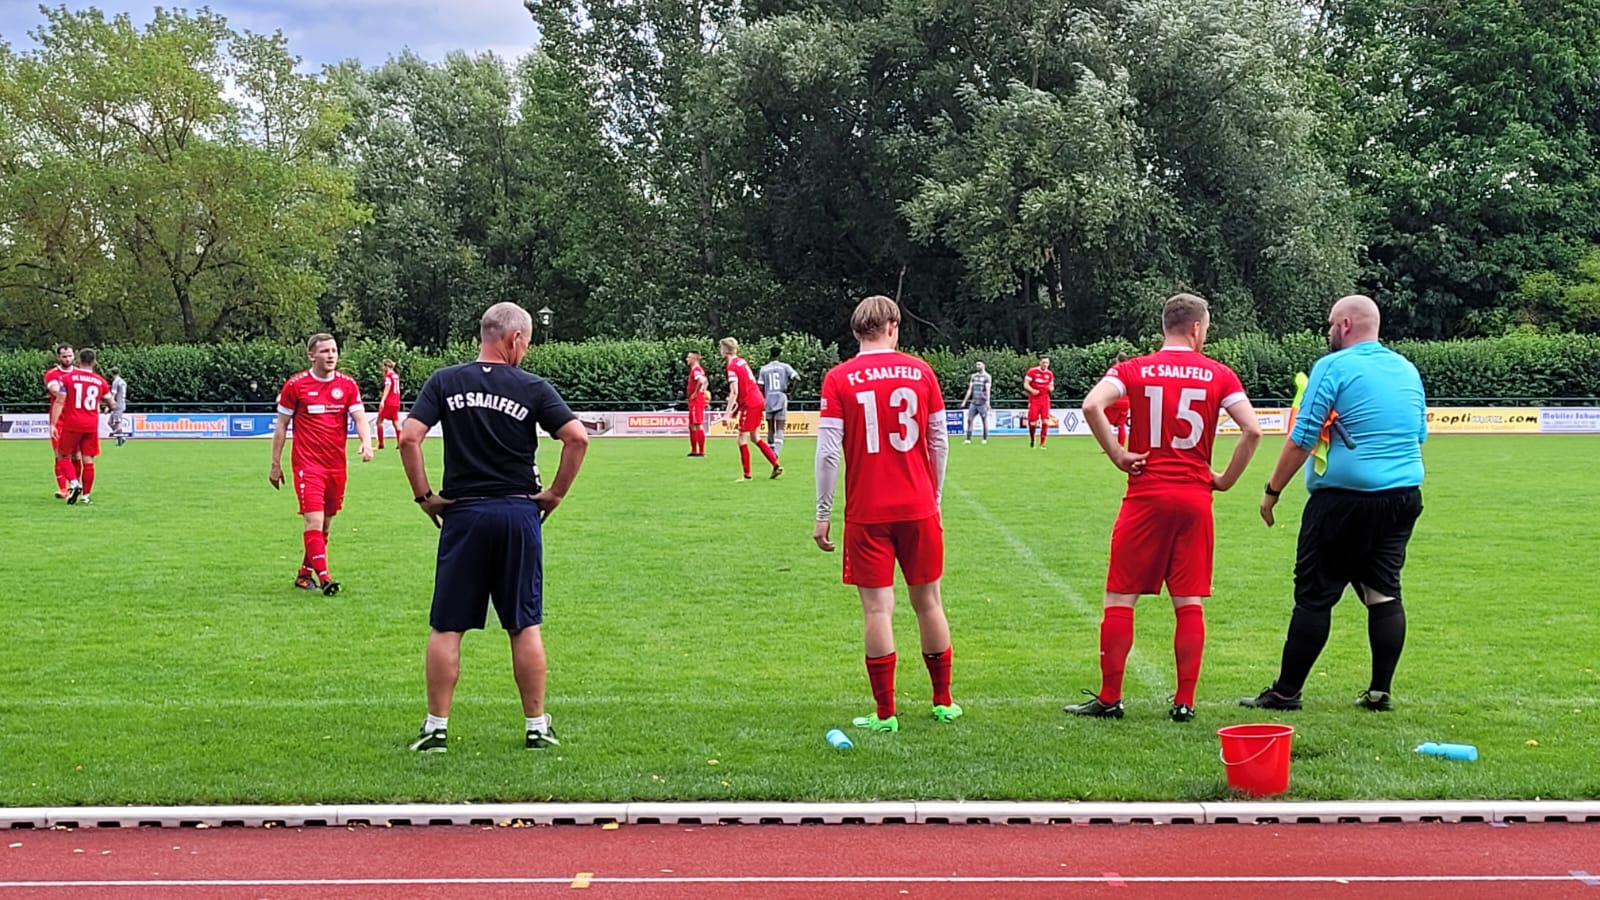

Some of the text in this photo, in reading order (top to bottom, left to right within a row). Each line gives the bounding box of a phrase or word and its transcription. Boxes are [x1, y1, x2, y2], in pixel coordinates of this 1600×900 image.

[768, 373, 781, 390] 16
[847, 366, 921, 386] FC SAALFELD
[1141, 364, 1213, 382] FC SAALFELD
[74, 383, 99, 411] 18
[446, 392, 529, 421] FC SAALFELD
[786, 423, 809, 432] RVICE
[856, 387, 919, 454] 13
[1144, 386, 1207, 450] 15
